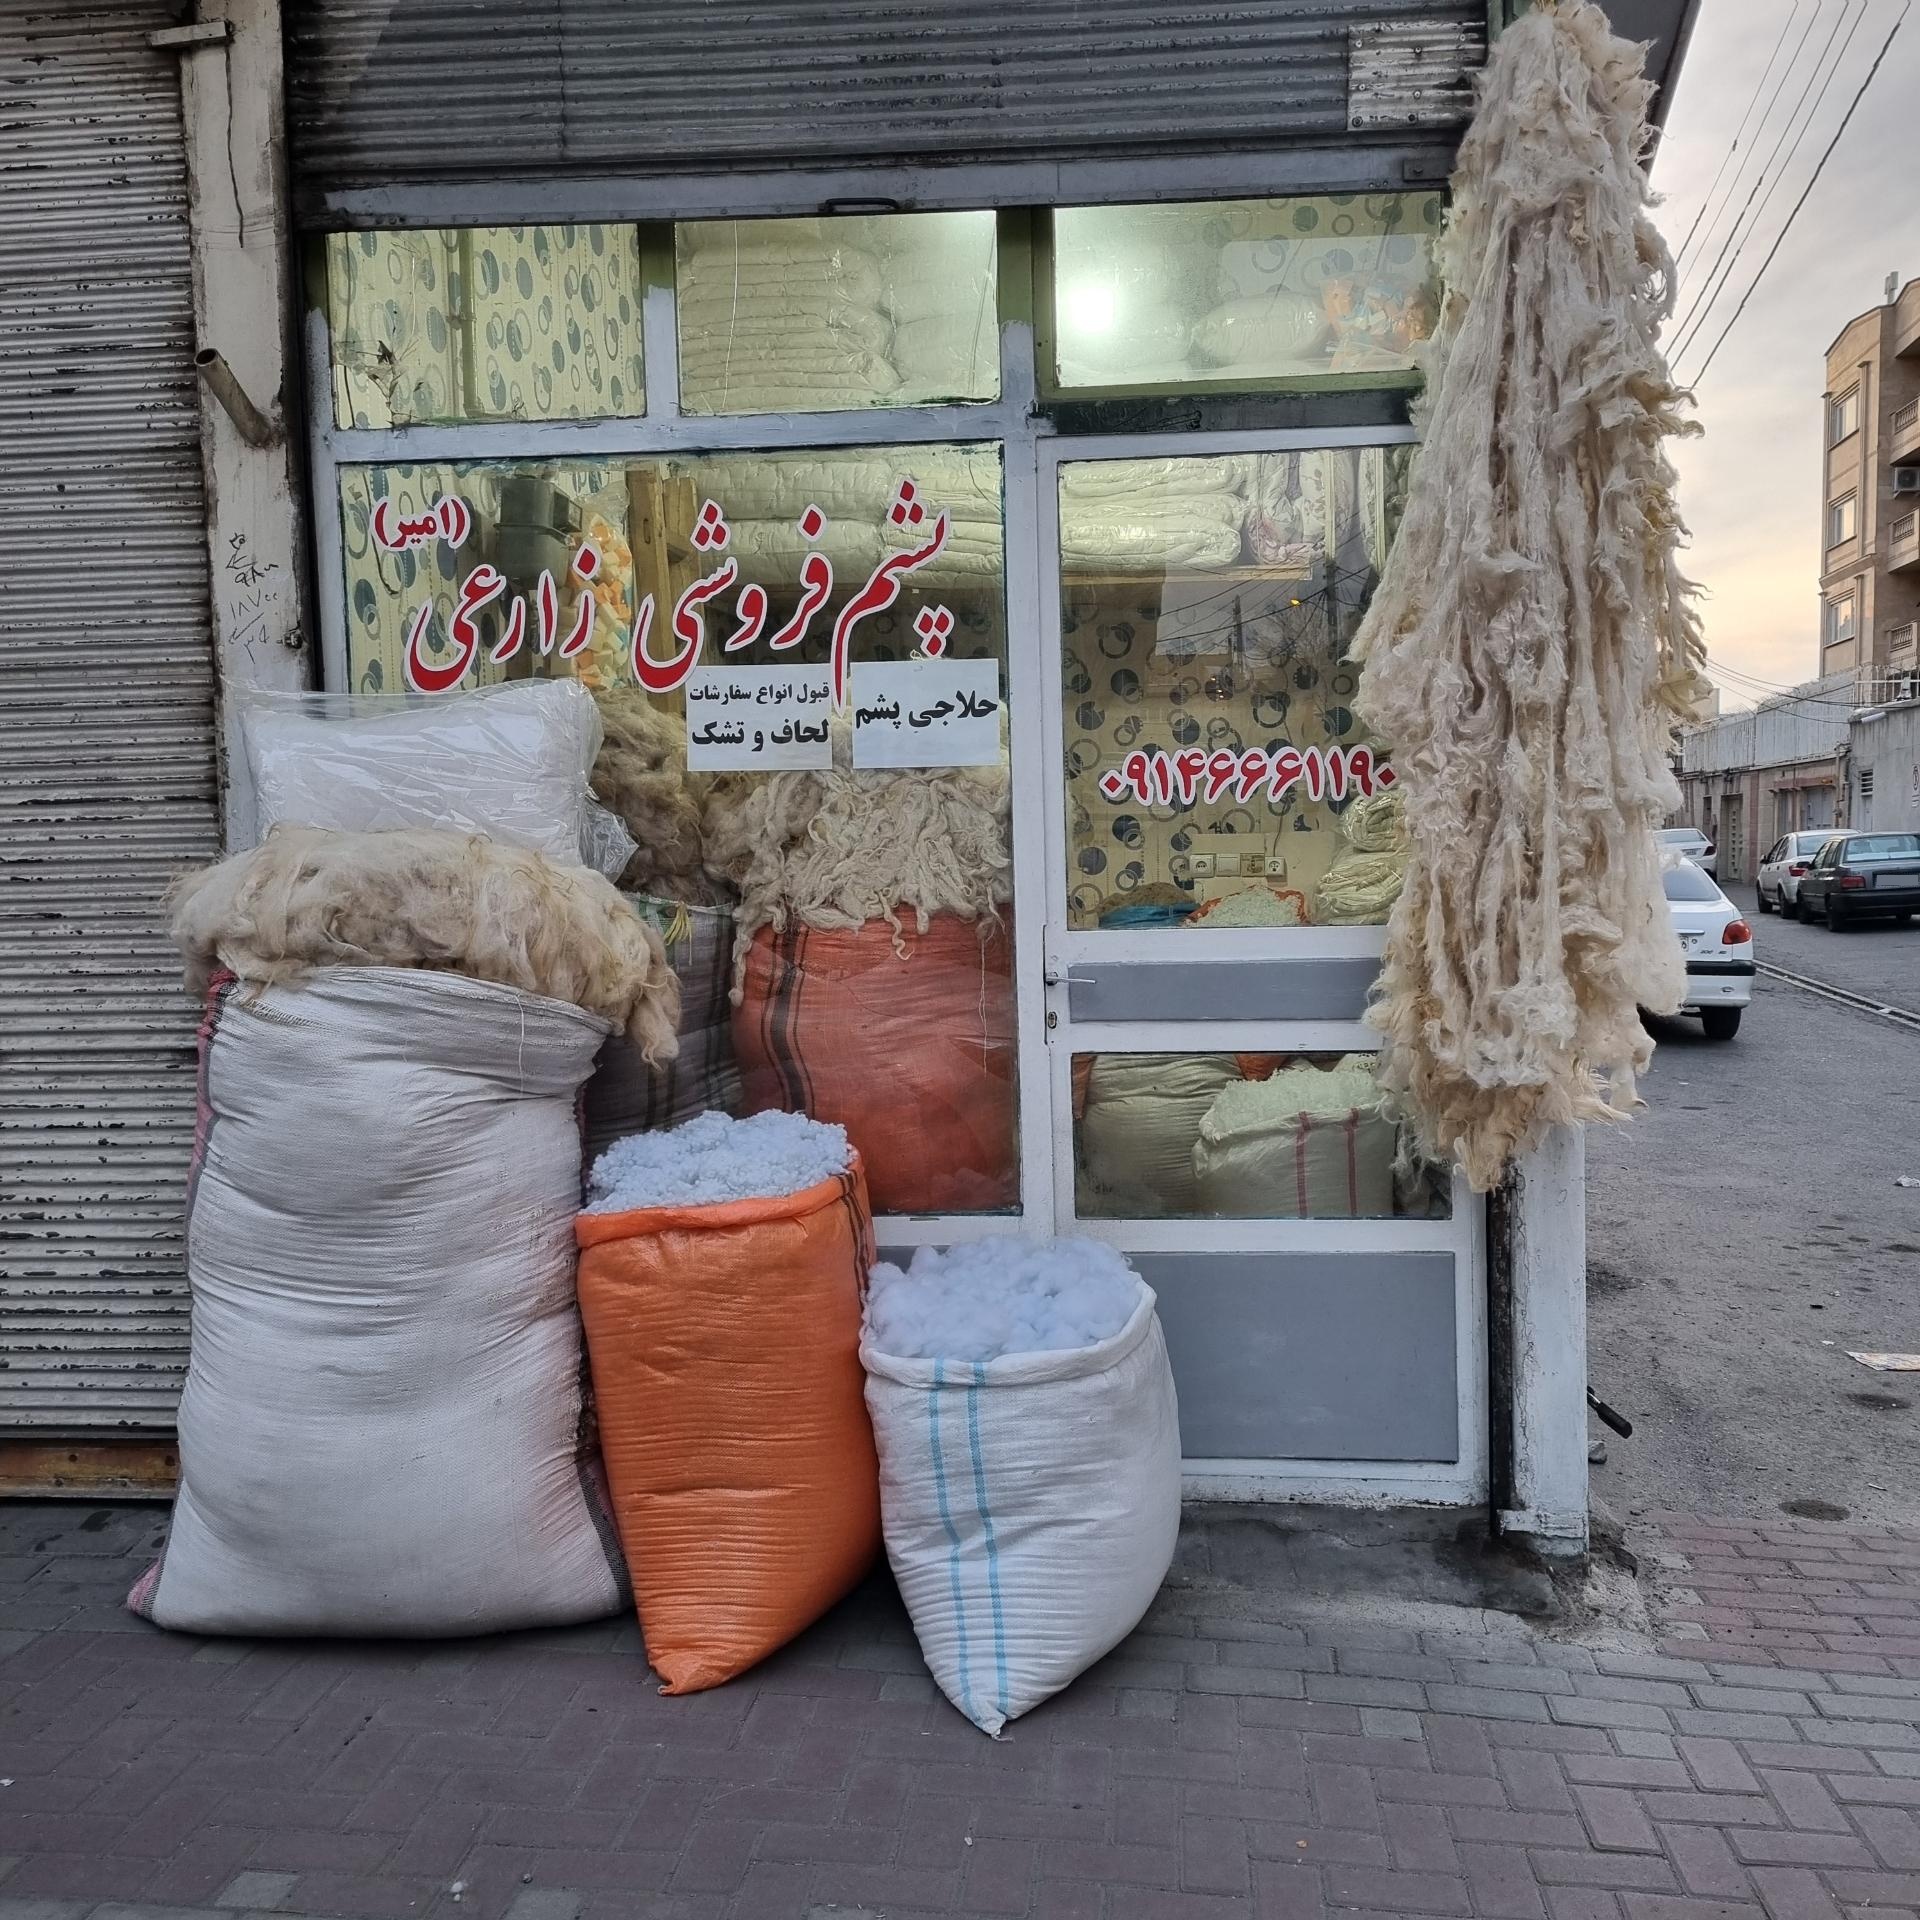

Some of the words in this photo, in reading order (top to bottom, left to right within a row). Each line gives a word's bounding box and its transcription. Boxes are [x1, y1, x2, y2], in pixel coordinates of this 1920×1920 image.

[633, 504, 830, 691] فروشی
[833, 482, 951, 709] پشم
[407, 548, 598, 693] زارعی
[689, 684, 752, 706] سفارشات
[755, 683, 793, 705] انواع
[796, 682, 830, 704] قبول
[855, 693, 902, 730] پشم
[691, 720, 745, 746] تشک
[751, 730, 765, 752] و
[770, 718, 830, 745] لحاف
[1102, 749, 1397, 802] ۰۹۱۴۶۶۶۱۱۹۰
